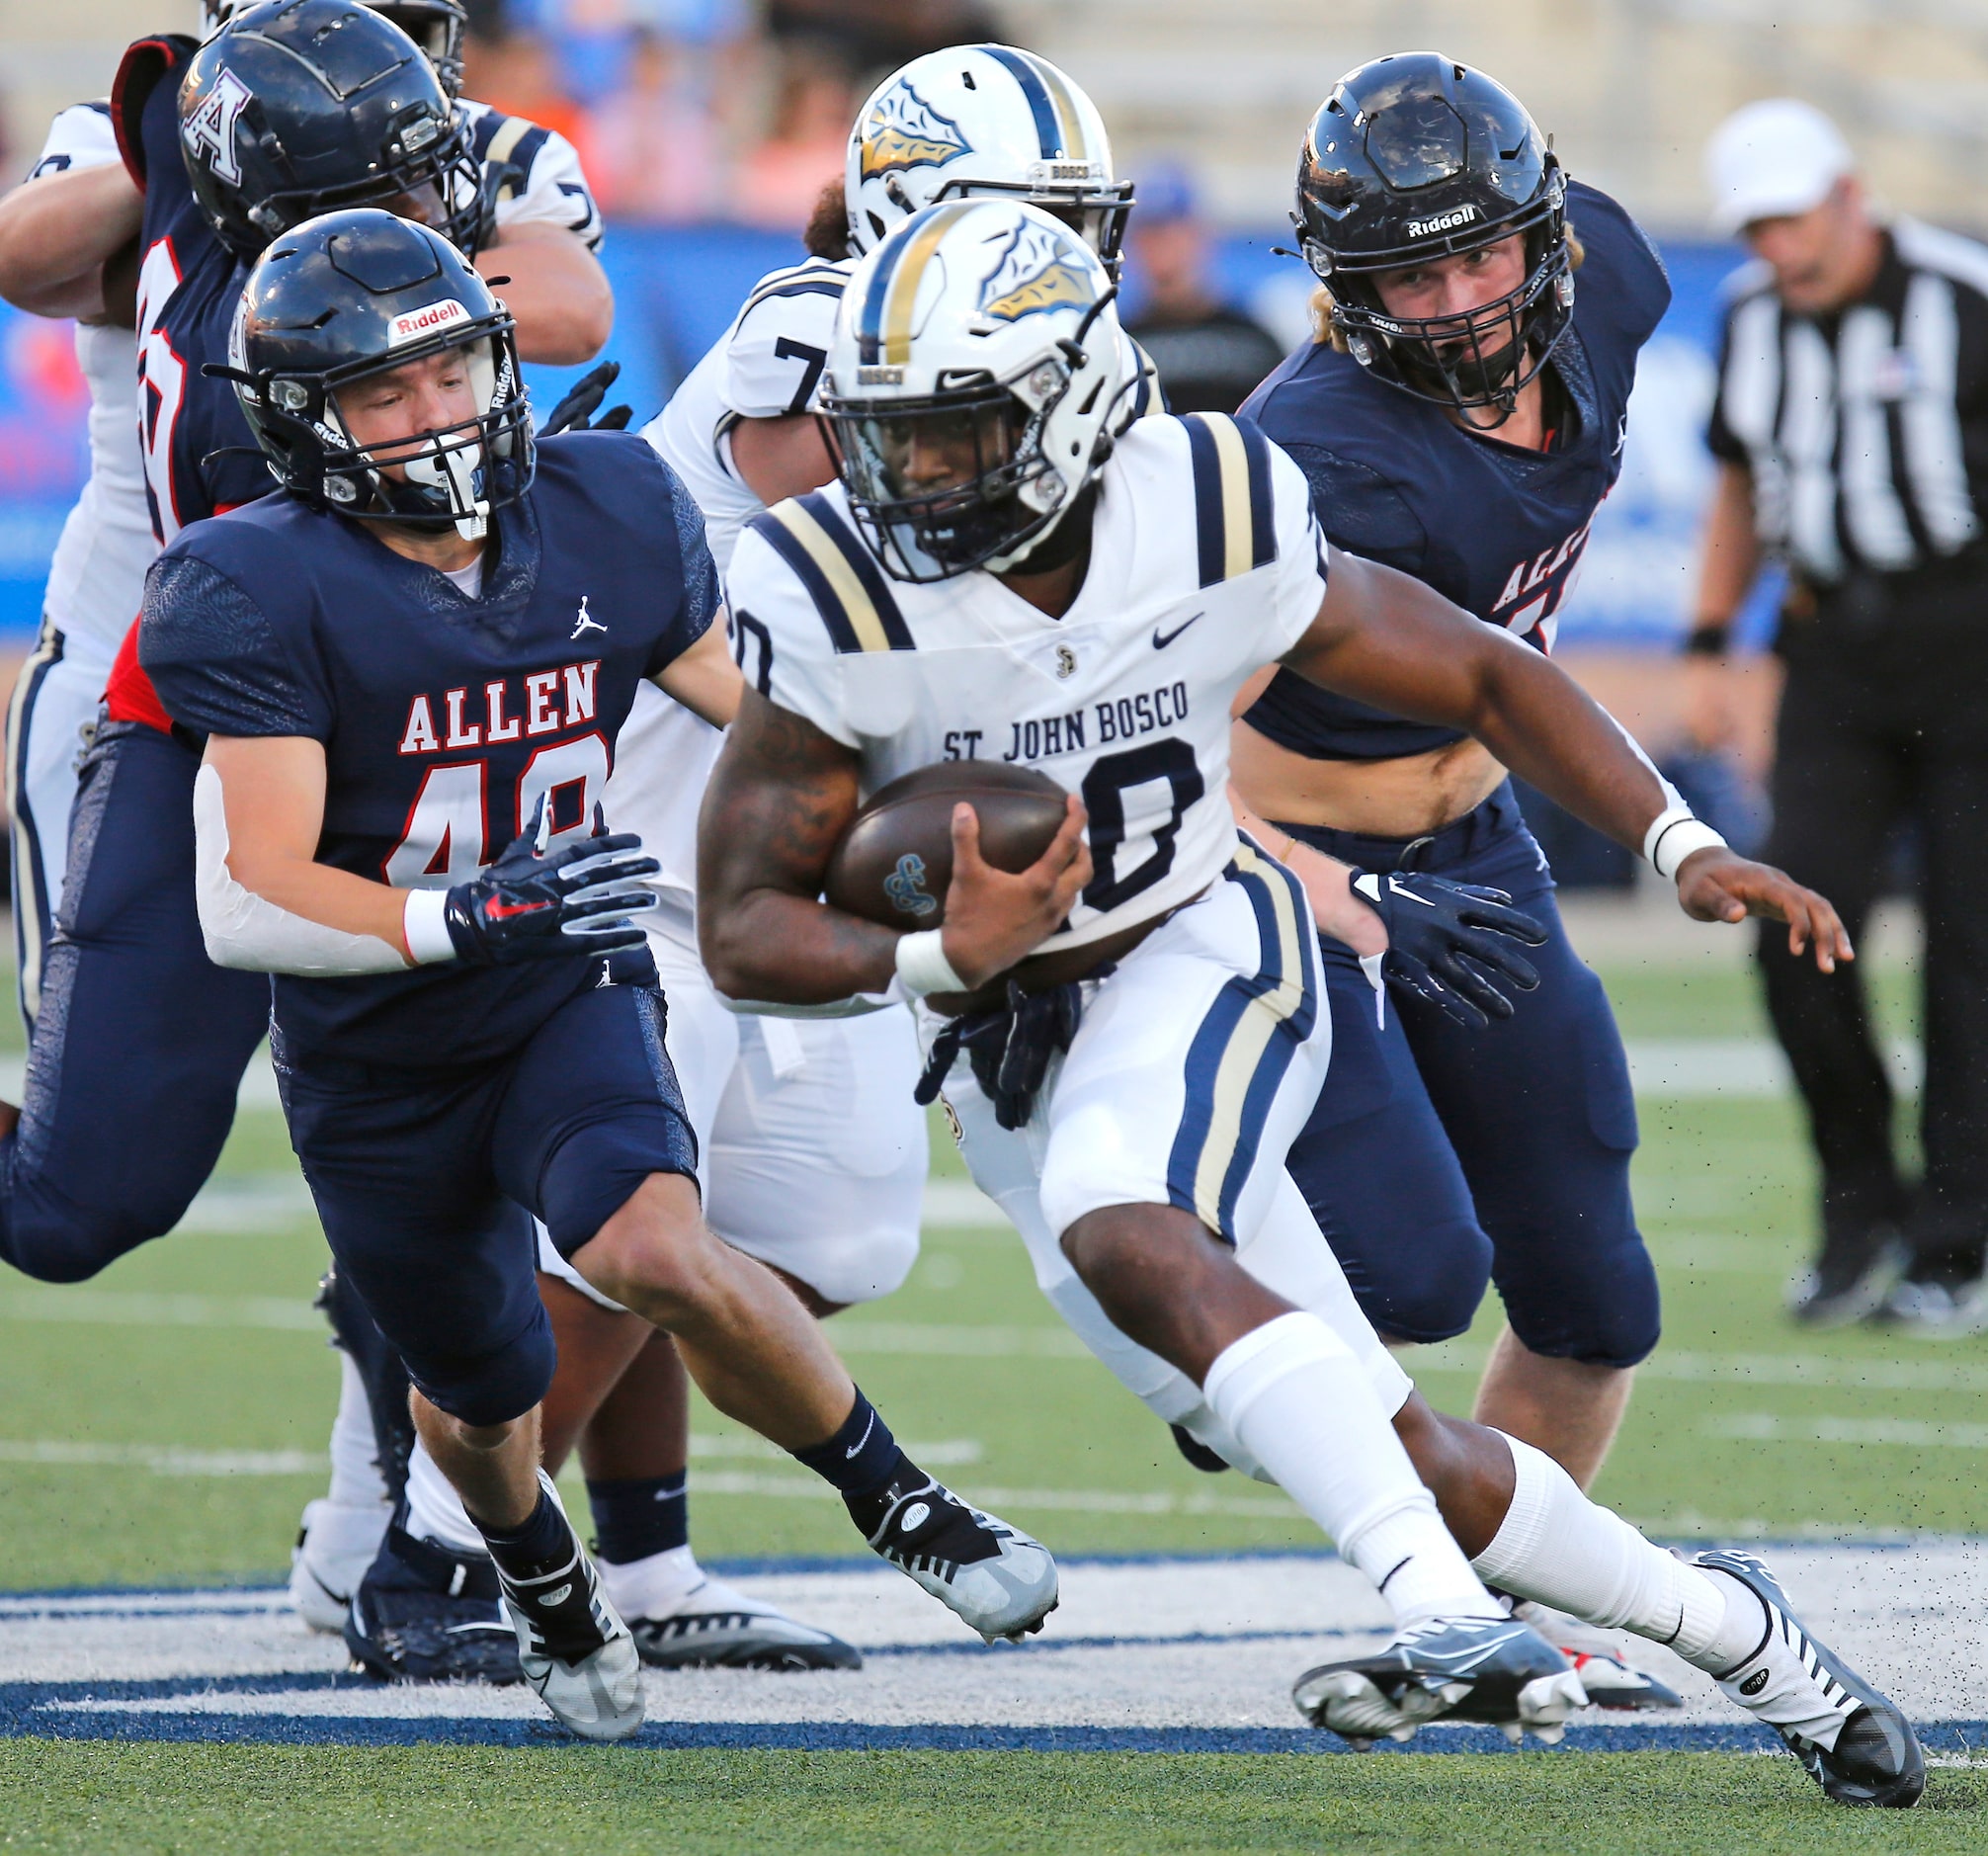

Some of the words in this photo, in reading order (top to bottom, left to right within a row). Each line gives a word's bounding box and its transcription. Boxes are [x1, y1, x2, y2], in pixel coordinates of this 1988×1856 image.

[1407, 206, 1475, 238] Riddell
[396, 301, 459, 335] Riddell
[775, 336, 828, 415] 7
[398, 659, 602, 756] ALLEN
[944, 730, 983, 762] ST
[1004, 711, 1085, 761] JOHN
[1096, 681, 1188, 743] BOSCO
